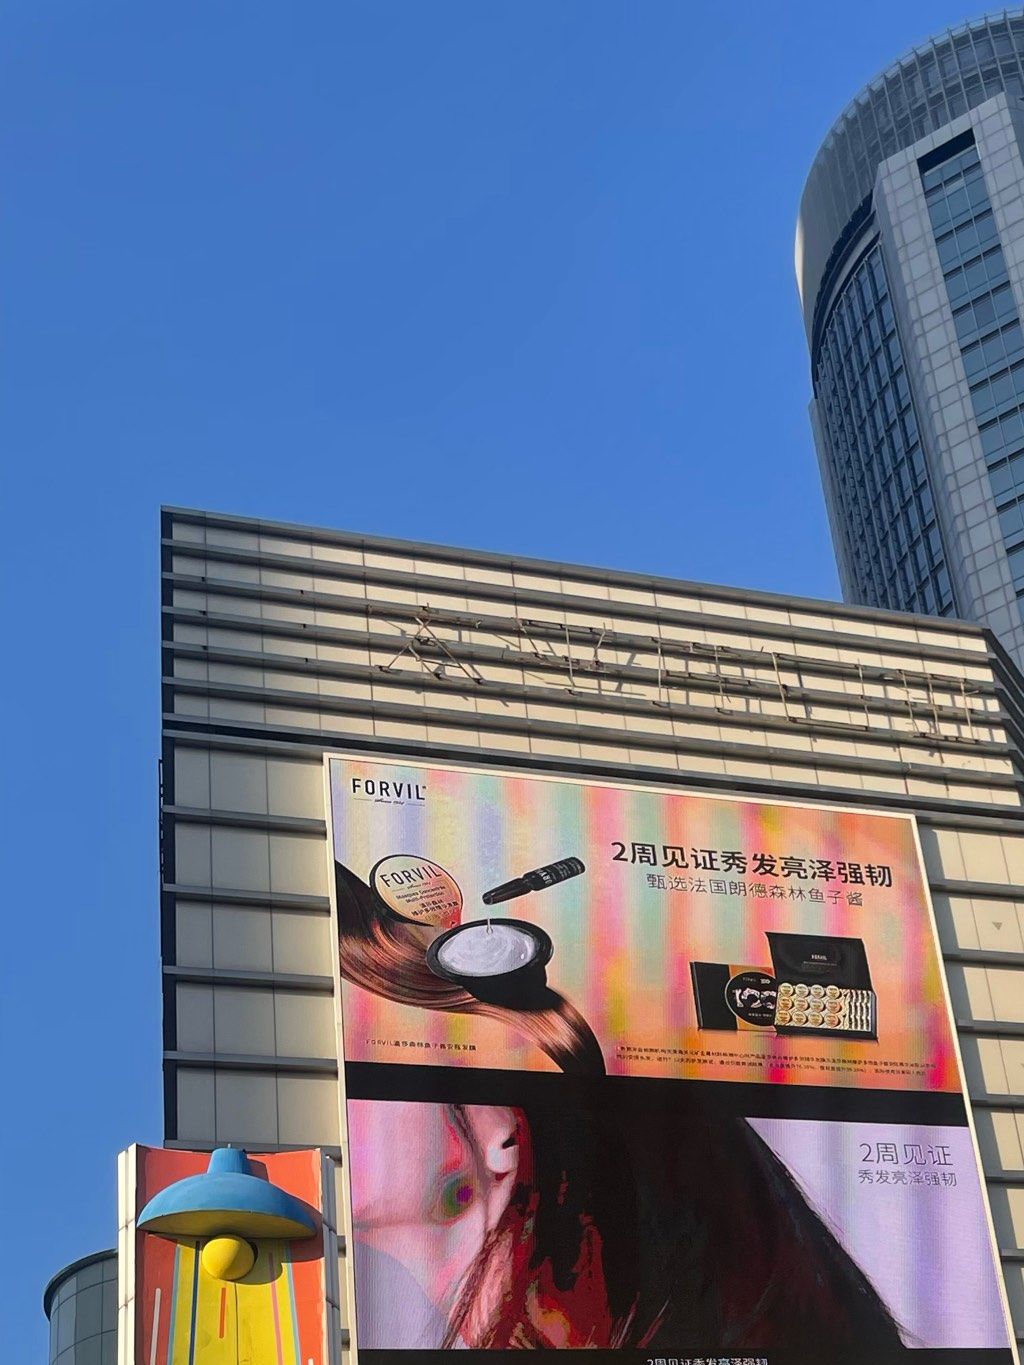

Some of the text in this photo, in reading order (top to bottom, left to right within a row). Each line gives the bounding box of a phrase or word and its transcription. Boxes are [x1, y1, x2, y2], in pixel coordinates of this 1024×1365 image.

[352, 778, 426, 800] FORVIL
[611, 841, 892, 888] 2周见证秀发亮泽强韧
[379, 865, 442, 888] FORVIL
[646, 873, 864, 907] 甄选法国朗德森林鱼子酱
[859, 1142, 953, 1166] 2周见证
[858, 1169, 957, 1187] 秀发亮泽强韧
